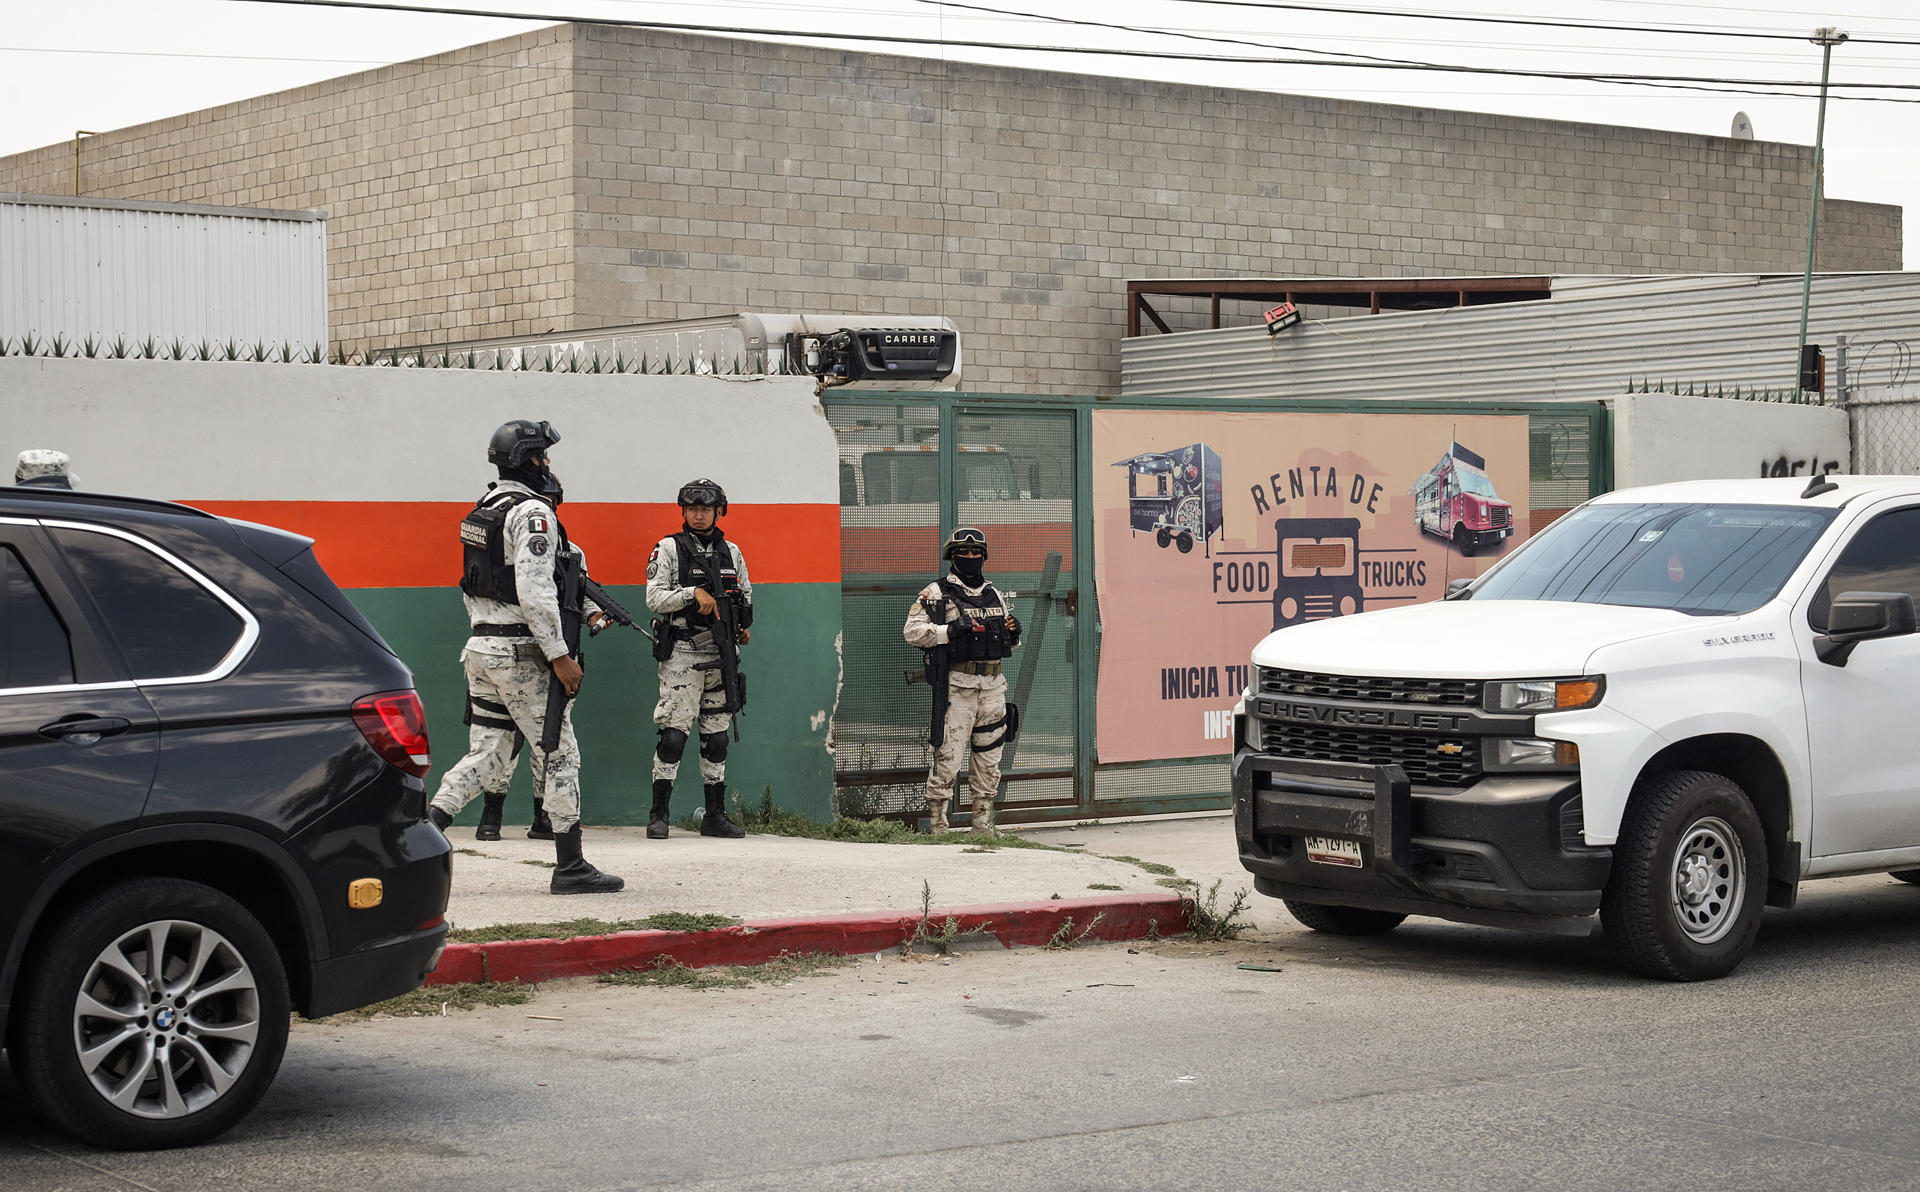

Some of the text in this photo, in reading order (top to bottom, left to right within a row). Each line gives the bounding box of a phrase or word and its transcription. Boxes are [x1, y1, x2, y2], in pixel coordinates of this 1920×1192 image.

[885, 334, 936, 344] CARRIER
[1250, 466, 1384, 515] RENTA DE
[1213, 560, 1427, 593] FOOD TRUCKS
[1161, 664, 1249, 700] INICIA TU
[1257, 700, 1470, 731] CHEVROLET
